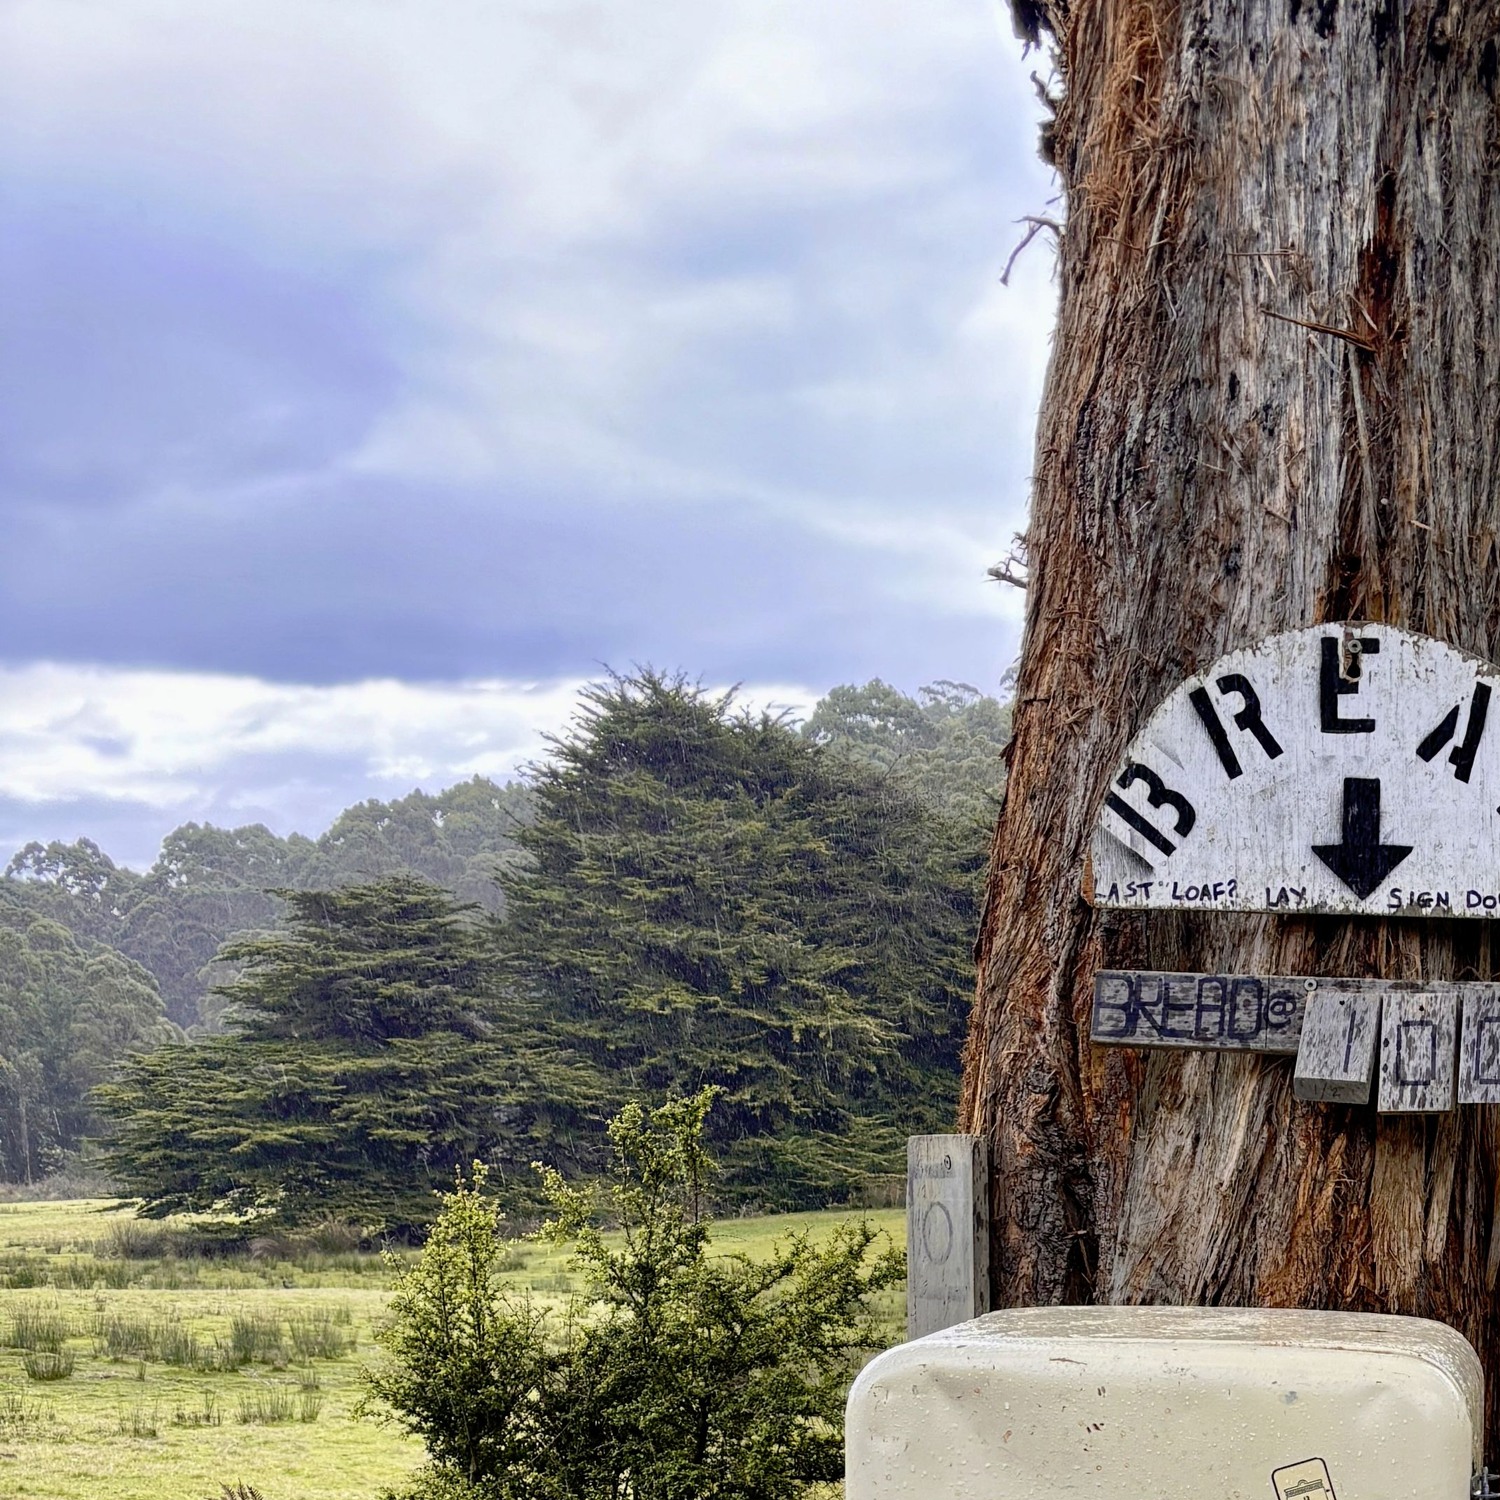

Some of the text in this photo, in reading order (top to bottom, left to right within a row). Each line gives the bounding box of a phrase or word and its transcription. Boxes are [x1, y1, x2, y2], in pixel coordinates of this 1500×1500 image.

[1171, 878, 1238, 907] LOAF?
[1265, 886, 1307, 909] LAY
[1387, 887, 1450, 909] SIGN
